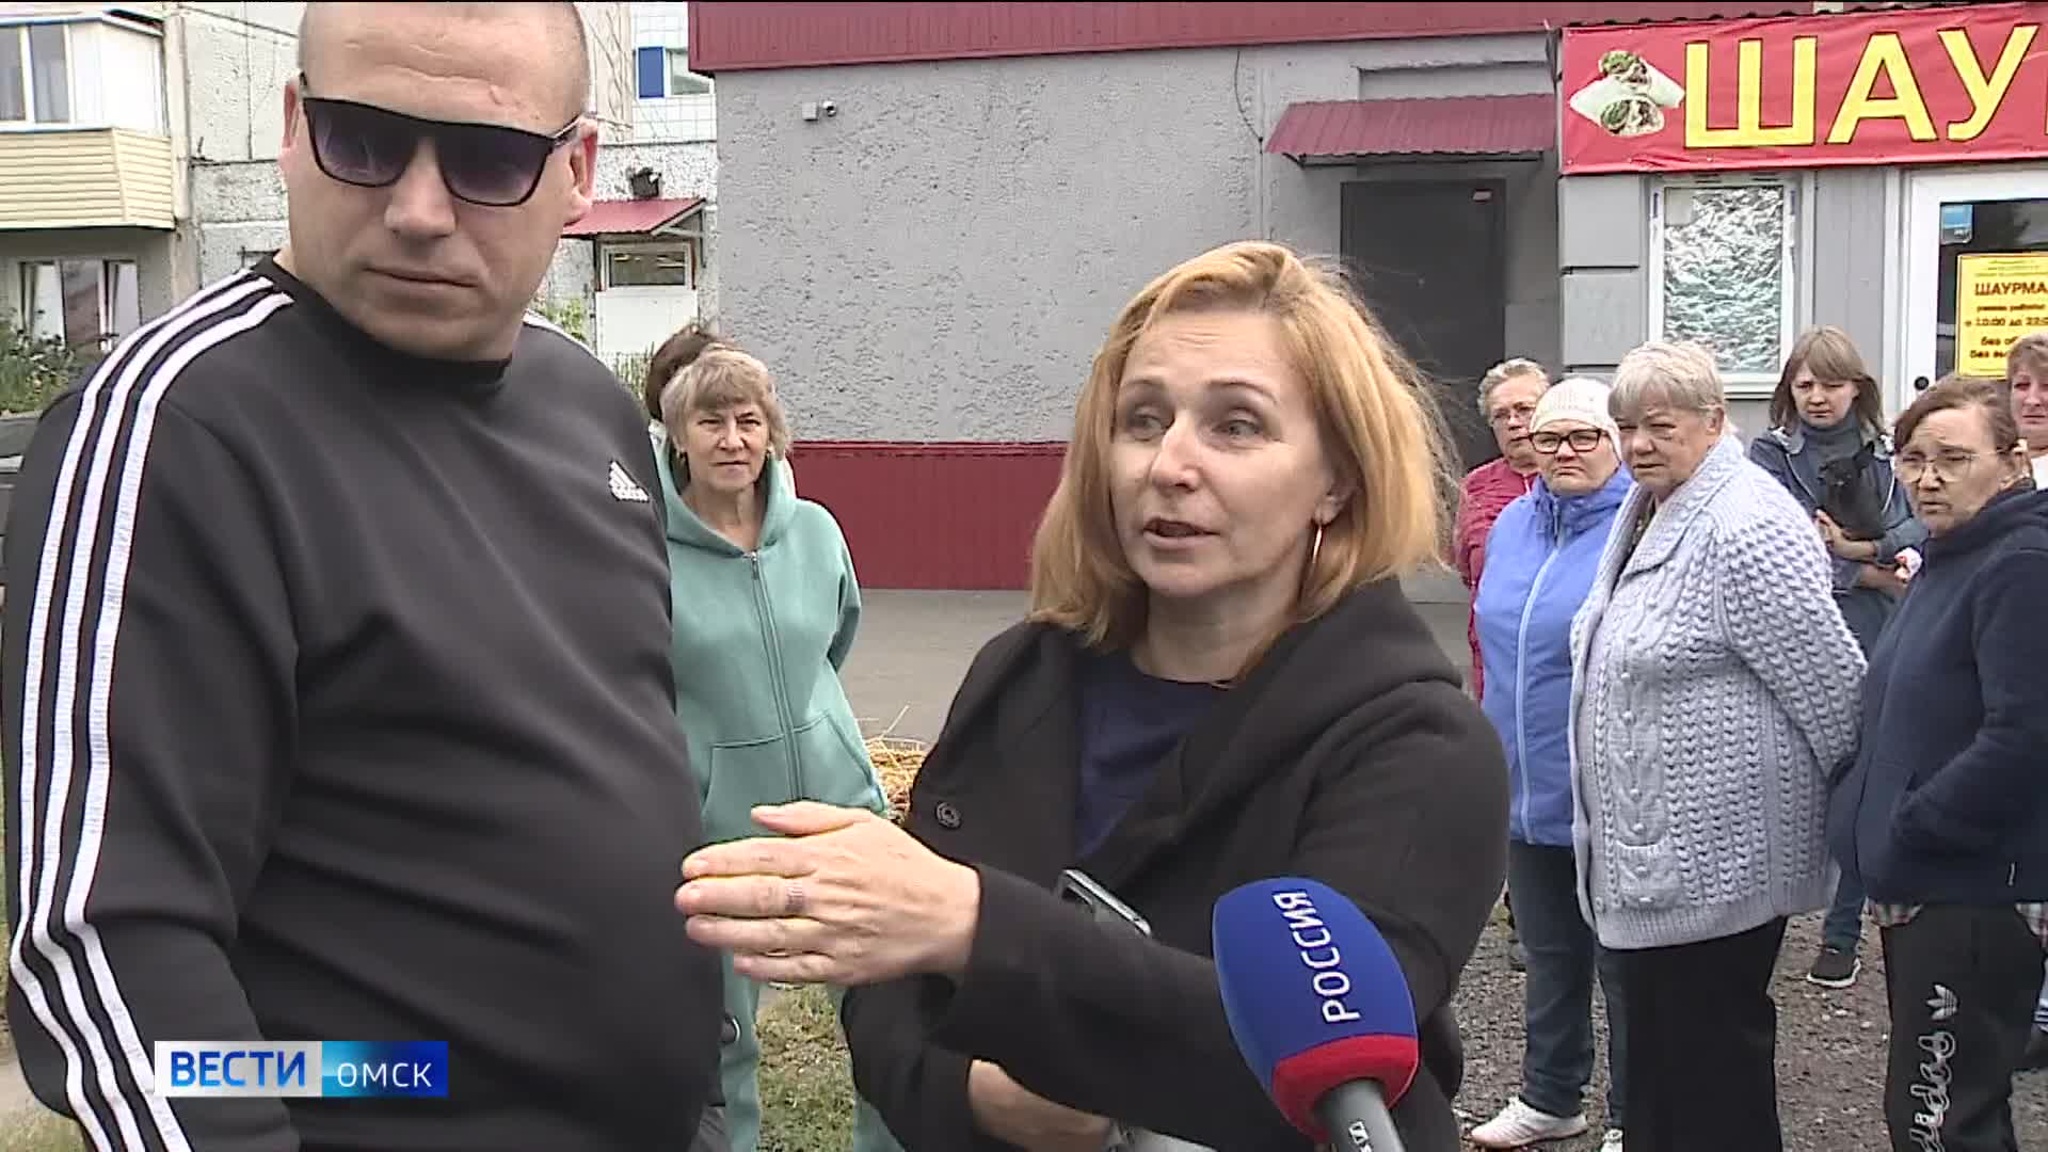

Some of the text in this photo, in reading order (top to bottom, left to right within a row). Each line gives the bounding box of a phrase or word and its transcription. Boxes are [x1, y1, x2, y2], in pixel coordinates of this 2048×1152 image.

[1684, 23, 2048, 148] ШАУ
[1272, 891, 1361, 1023] РОССИЯ
[1909, 1031, 1956, 1152] didas
